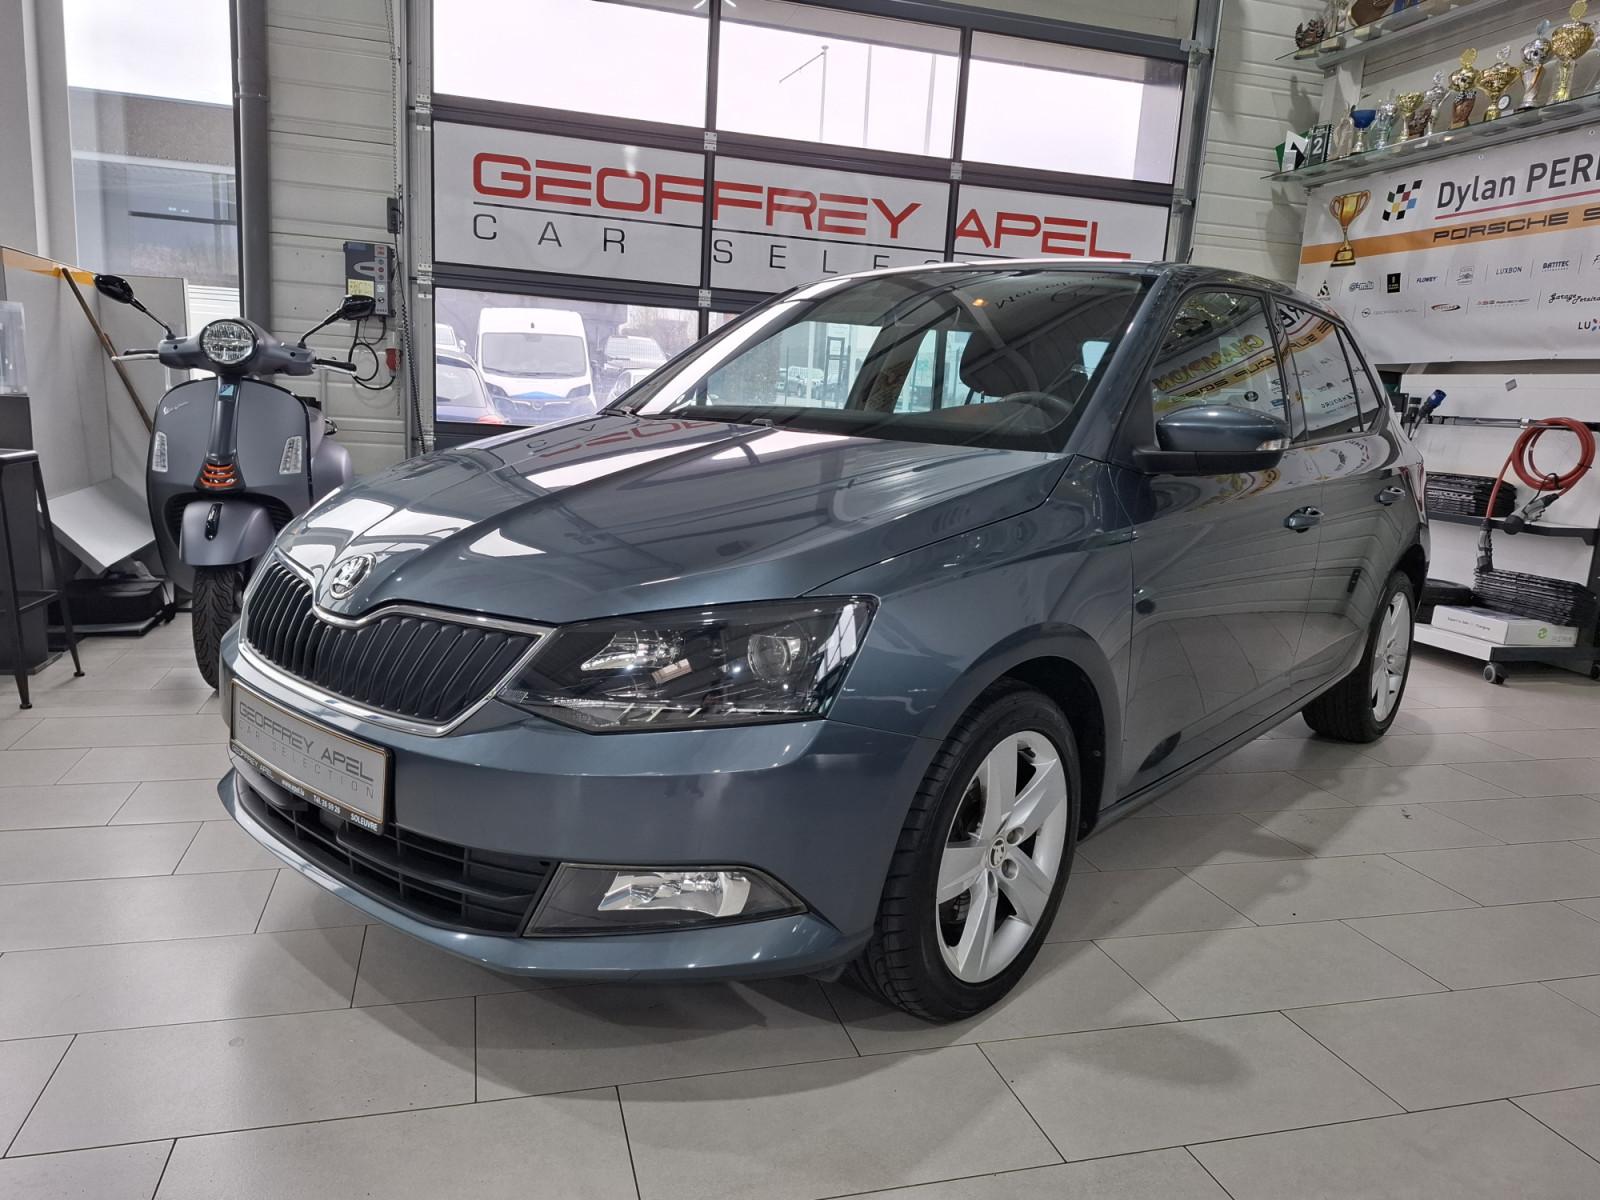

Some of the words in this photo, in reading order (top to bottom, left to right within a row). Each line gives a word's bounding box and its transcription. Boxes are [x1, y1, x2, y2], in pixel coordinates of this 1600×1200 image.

[473, 152, 923, 239] GEOFFREY
[955, 208, 1131, 259] APEL
[1437, 175, 1516, 212] Dylan
[1526, 153, 1600, 193] PER
[473, 213, 626, 254] CAR
[713, 239, 941, 274] SELE
[1433, 212, 1569, 243] PORSCHE
[239, 701, 314, 755] GEOFFREY
[321, 747, 374, 782] APEL
[350, 813, 378, 832] SOLEUVRE
